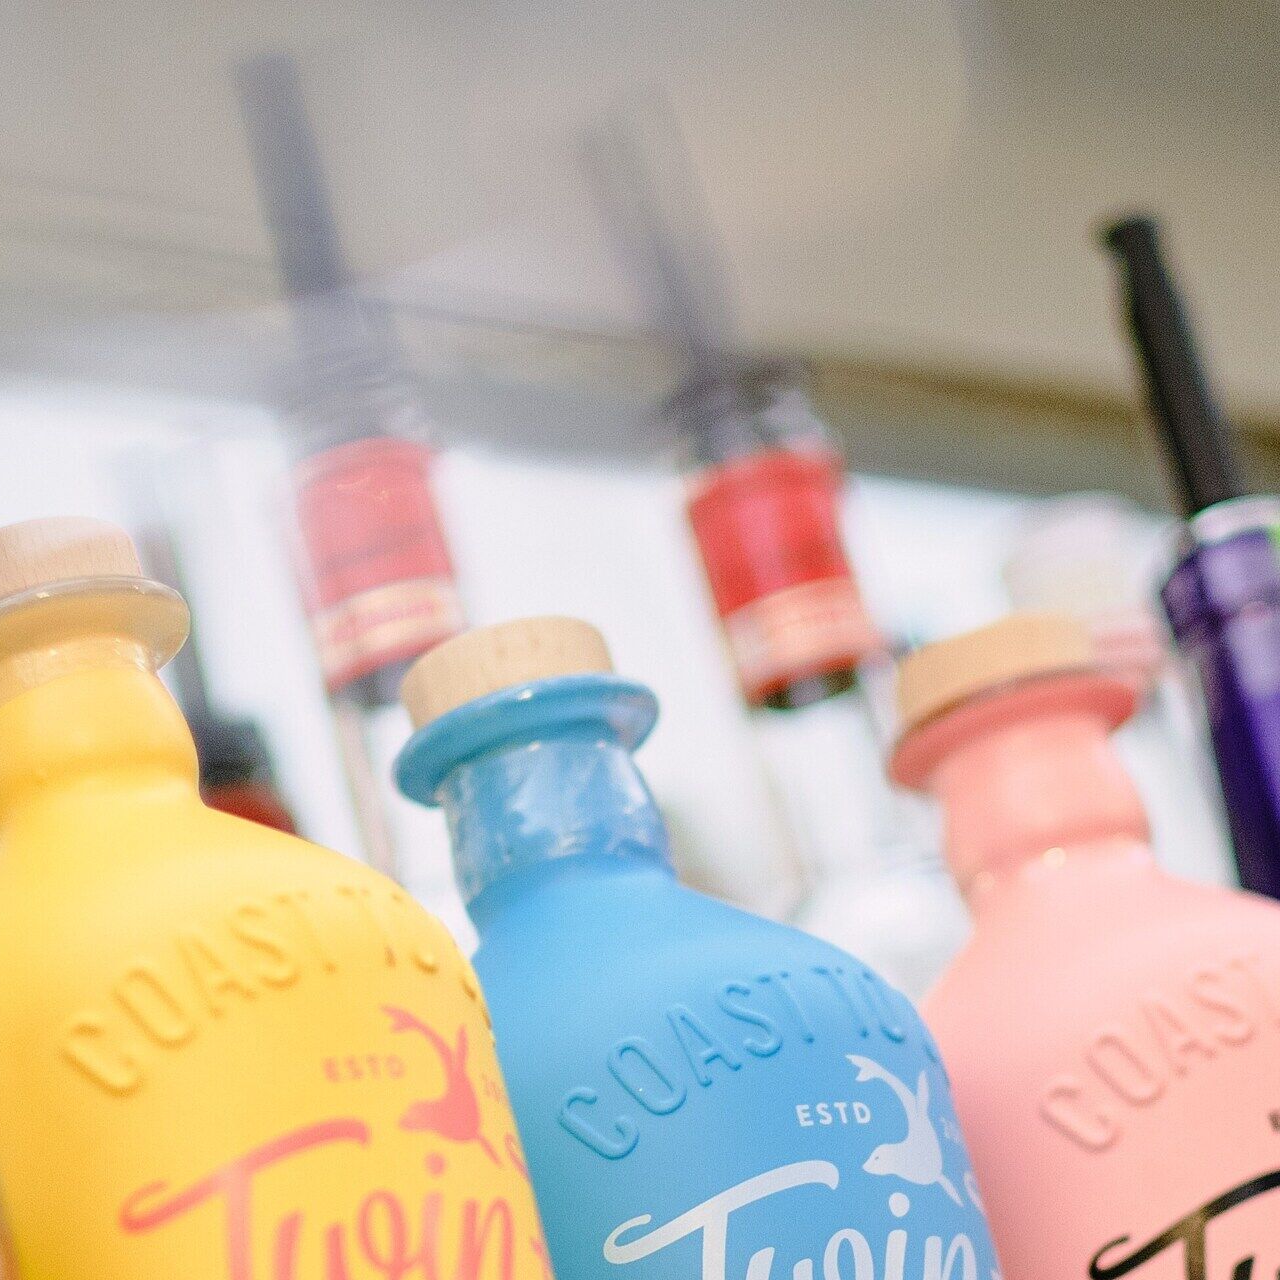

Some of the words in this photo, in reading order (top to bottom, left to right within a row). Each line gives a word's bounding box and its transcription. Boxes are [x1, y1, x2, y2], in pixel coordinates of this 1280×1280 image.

[58, 890, 340, 1100] COAST
[322, 1053, 407, 1083] ESTD
[558, 969, 816, 1160] COAST
[795, 1101, 872, 1127] ESTD
